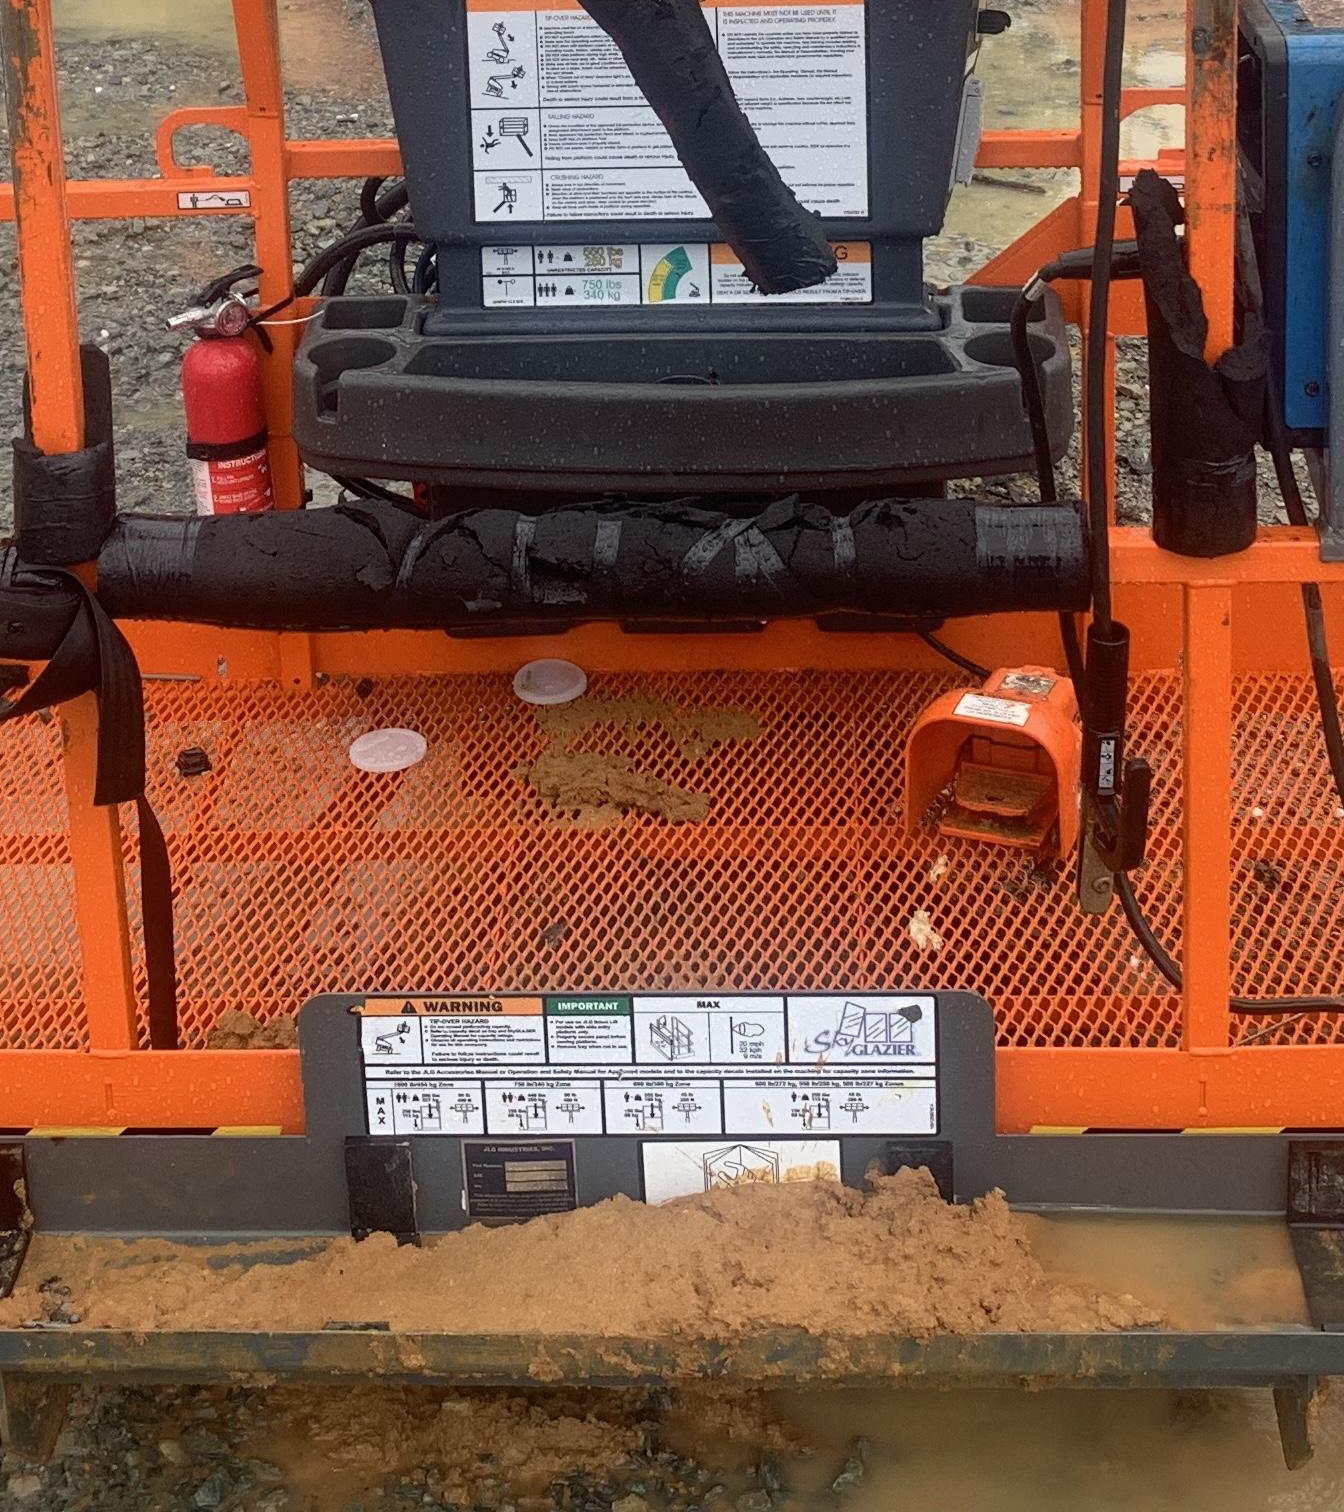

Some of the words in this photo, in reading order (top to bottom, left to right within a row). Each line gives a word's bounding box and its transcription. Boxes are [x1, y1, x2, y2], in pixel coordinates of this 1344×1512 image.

[582, 279, 602, 289] 750
[607, 279, 622, 289] lbs
[584, 290, 604, 300] 340
[608, 289, 621, 301] kg
[424, 1001, 503, 1012] WARNING
[558, 1002, 619, 1011] IMPORTANT
[697, 1001, 721, 1009] MAX
[376, 1097, 386, 1125] MAX
